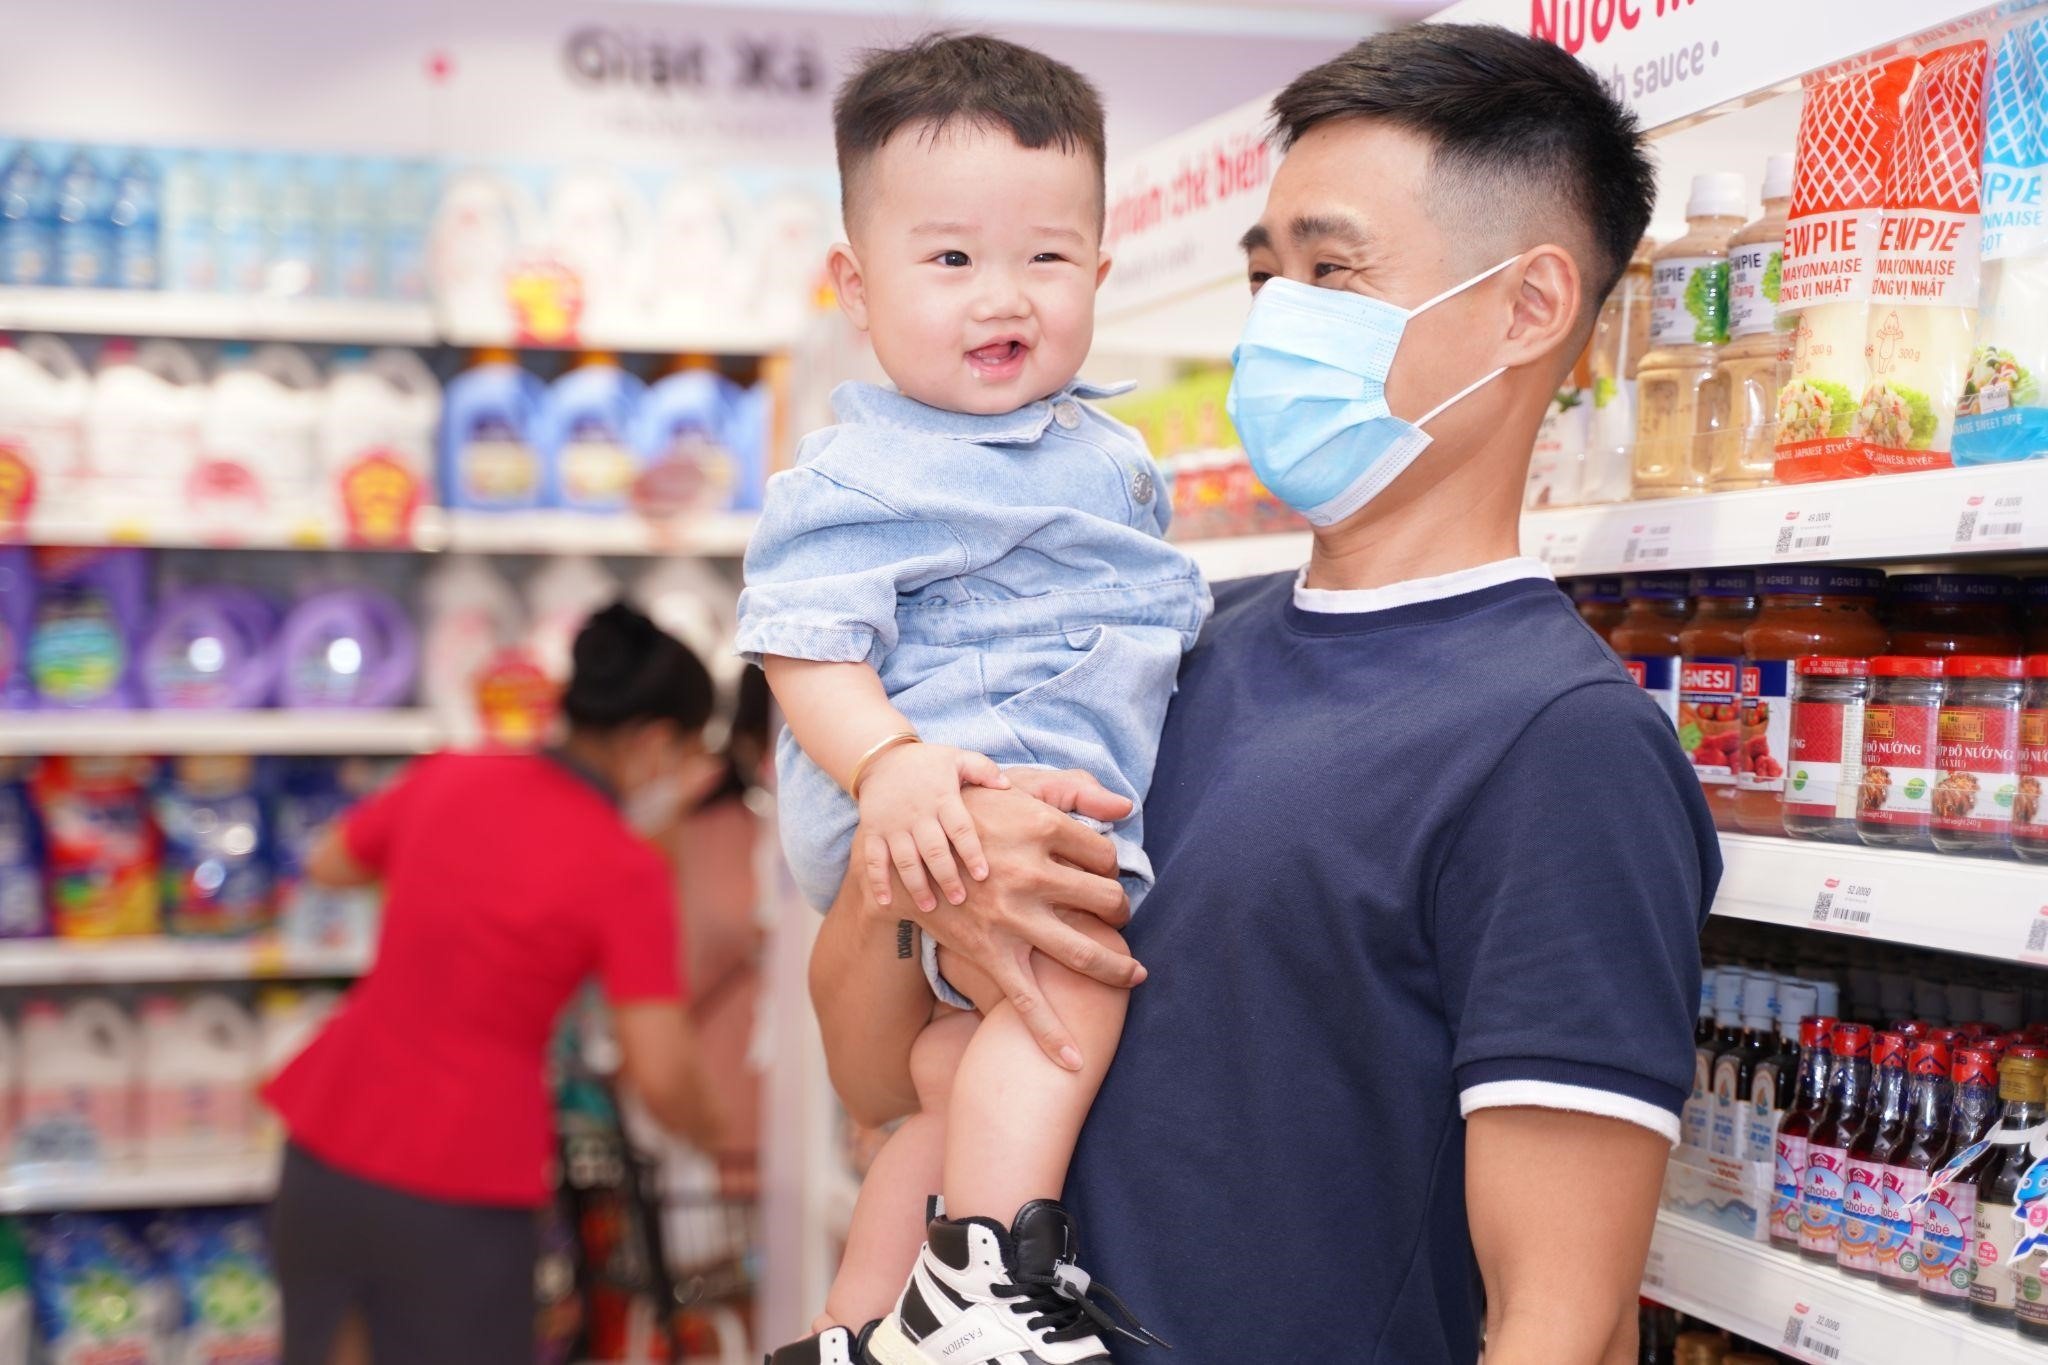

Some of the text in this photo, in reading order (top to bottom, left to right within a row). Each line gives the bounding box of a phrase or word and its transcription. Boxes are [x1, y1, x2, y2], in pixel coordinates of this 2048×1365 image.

[1633, 42, 1704, 98] sauce
[1981, 171, 2042, 206] PIE
[1879, 217, 1965, 251] EWPIE
[1783, 258, 1862, 282] MAYONNAISE
[1876, 258, 1956, 276] MAYONNAISE
[1811, 344, 1825, 356] 300
[1898, 348, 1913, 361] 300
[1845, 1199, 1875, 1216] chobé
[942, 1327, 983, 1356] FASHION
